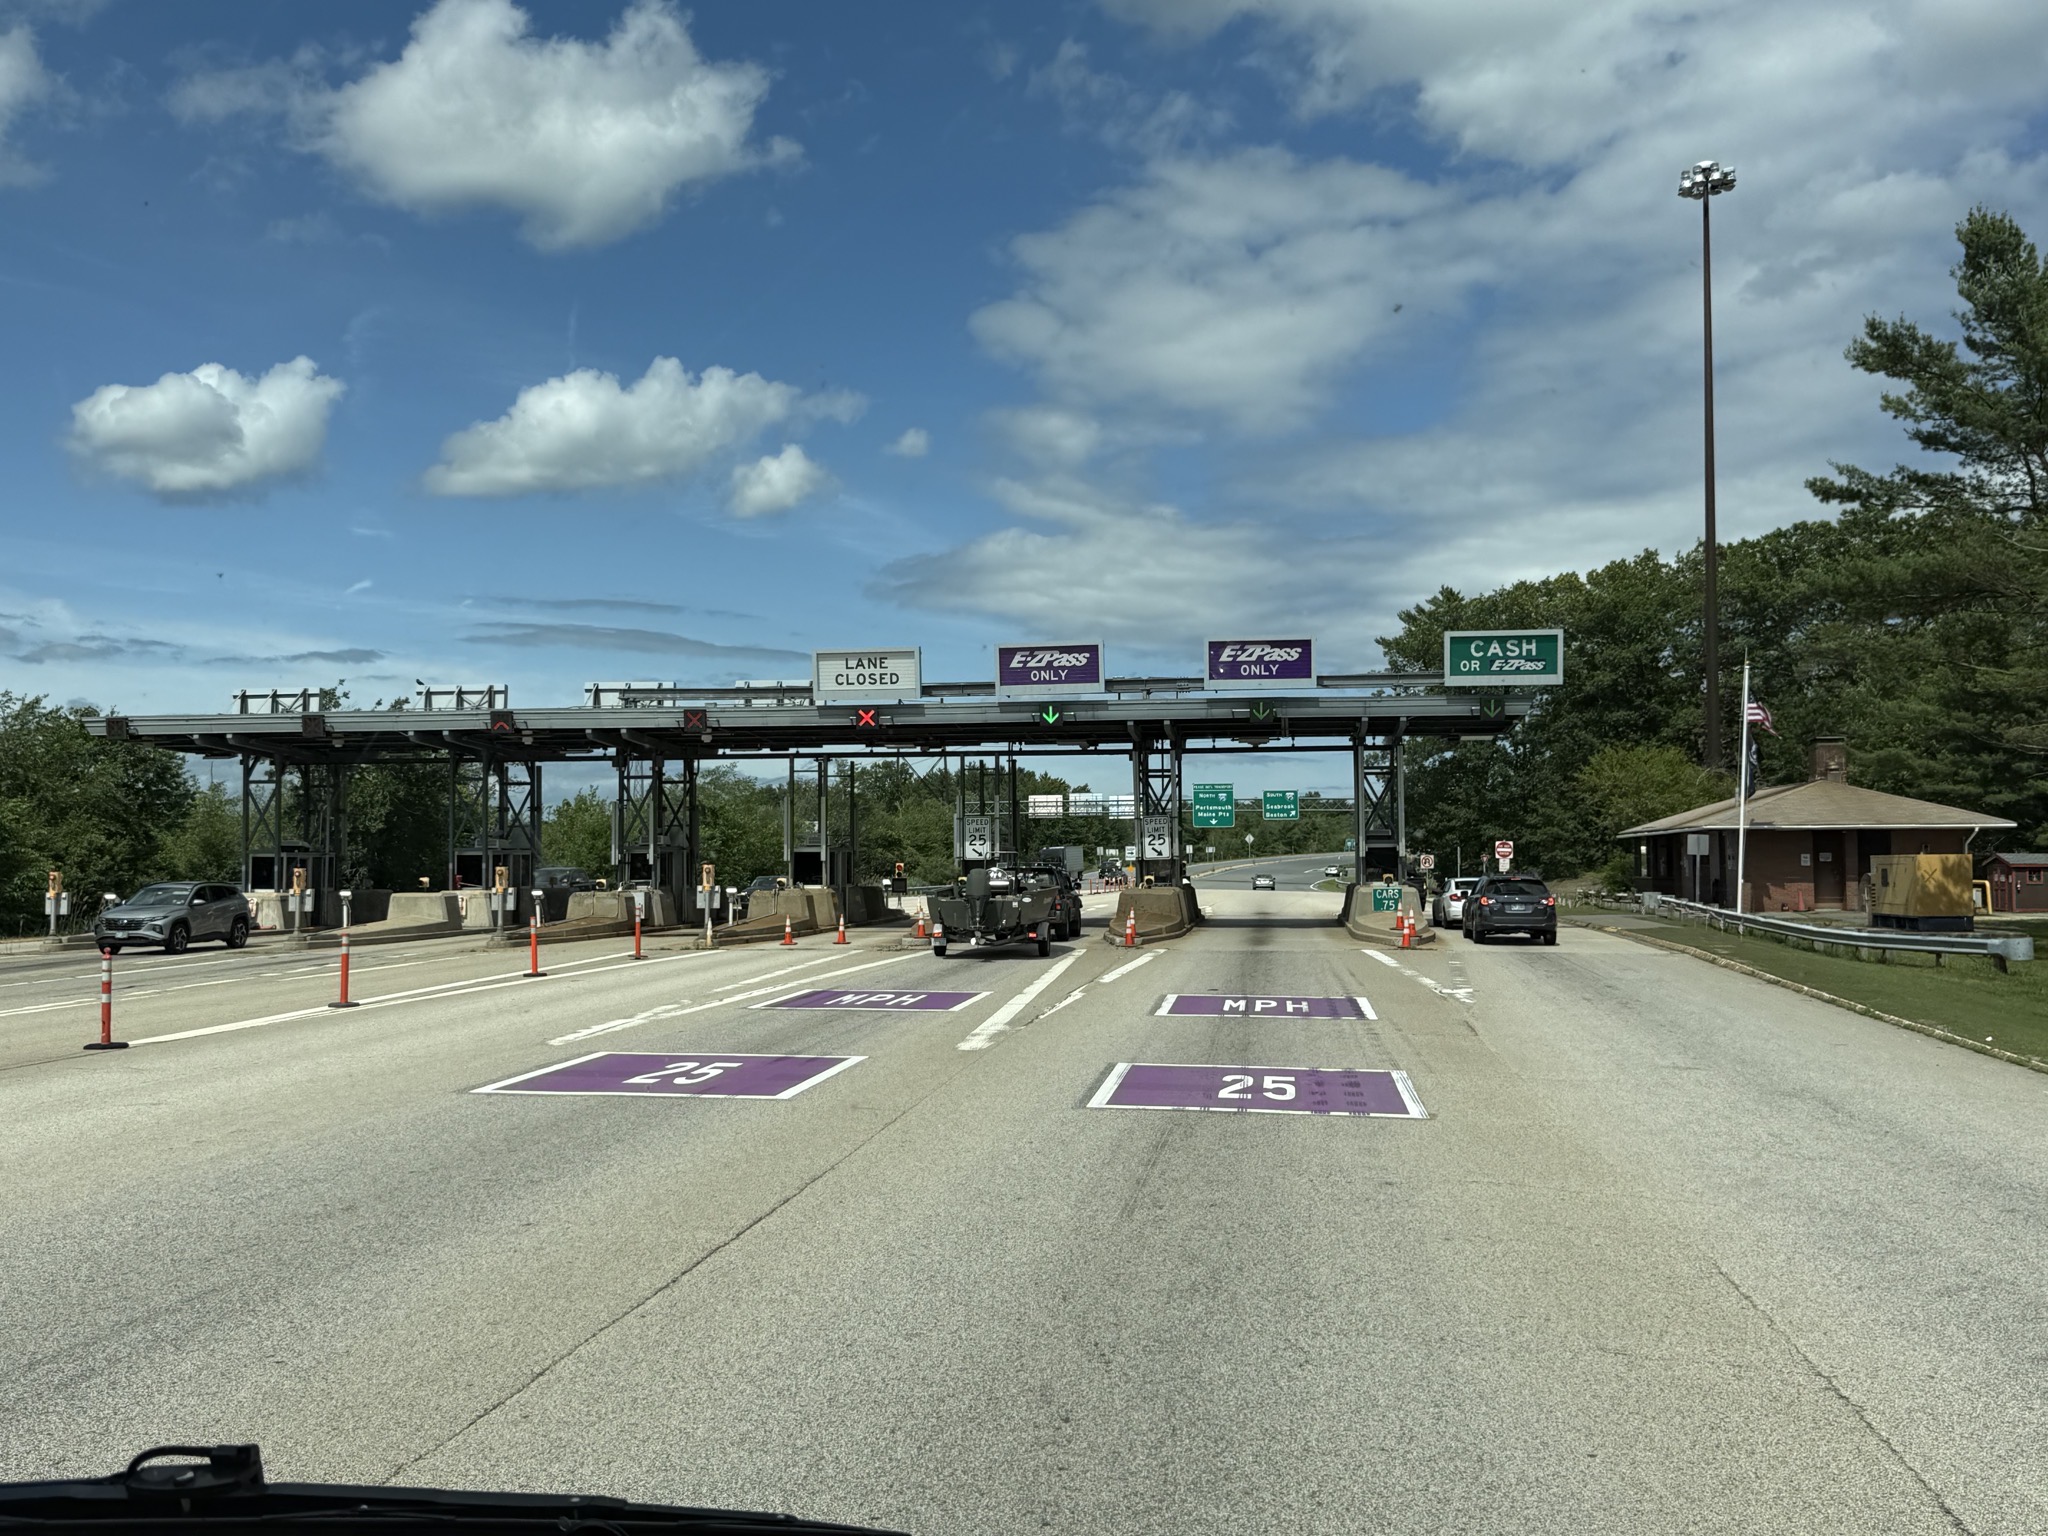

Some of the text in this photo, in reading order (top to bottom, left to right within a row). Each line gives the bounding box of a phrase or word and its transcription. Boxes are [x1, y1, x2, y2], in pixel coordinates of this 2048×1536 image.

[1470, 639, 1537, 657] CASH
[845, 657, 888, 669] LANE
[1460, 660, 1480, 671] OR
[1030, 669, 1068, 682] ONLY
[1240, 664, 1279, 676] ONLY
[835, 673, 900, 686] CLOSED
[966, 818, 989, 826] SPEED
[1144, 818, 1168, 826] SPEED
[1147, 826, 1166, 834] LIMIT
[968, 834, 987, 846] 25
[1147, 833, 1166, 846] 25
[1376, 889, 1400, 899] CARS
[1380, 900, 1396, 911] .75
[826, 993, 930, 1006] MPH
[1222, 999, 1310, 1013] MPH
[621, 1061, 743, 1086] 25
[1217, 1074, 1297, 1101] 25
